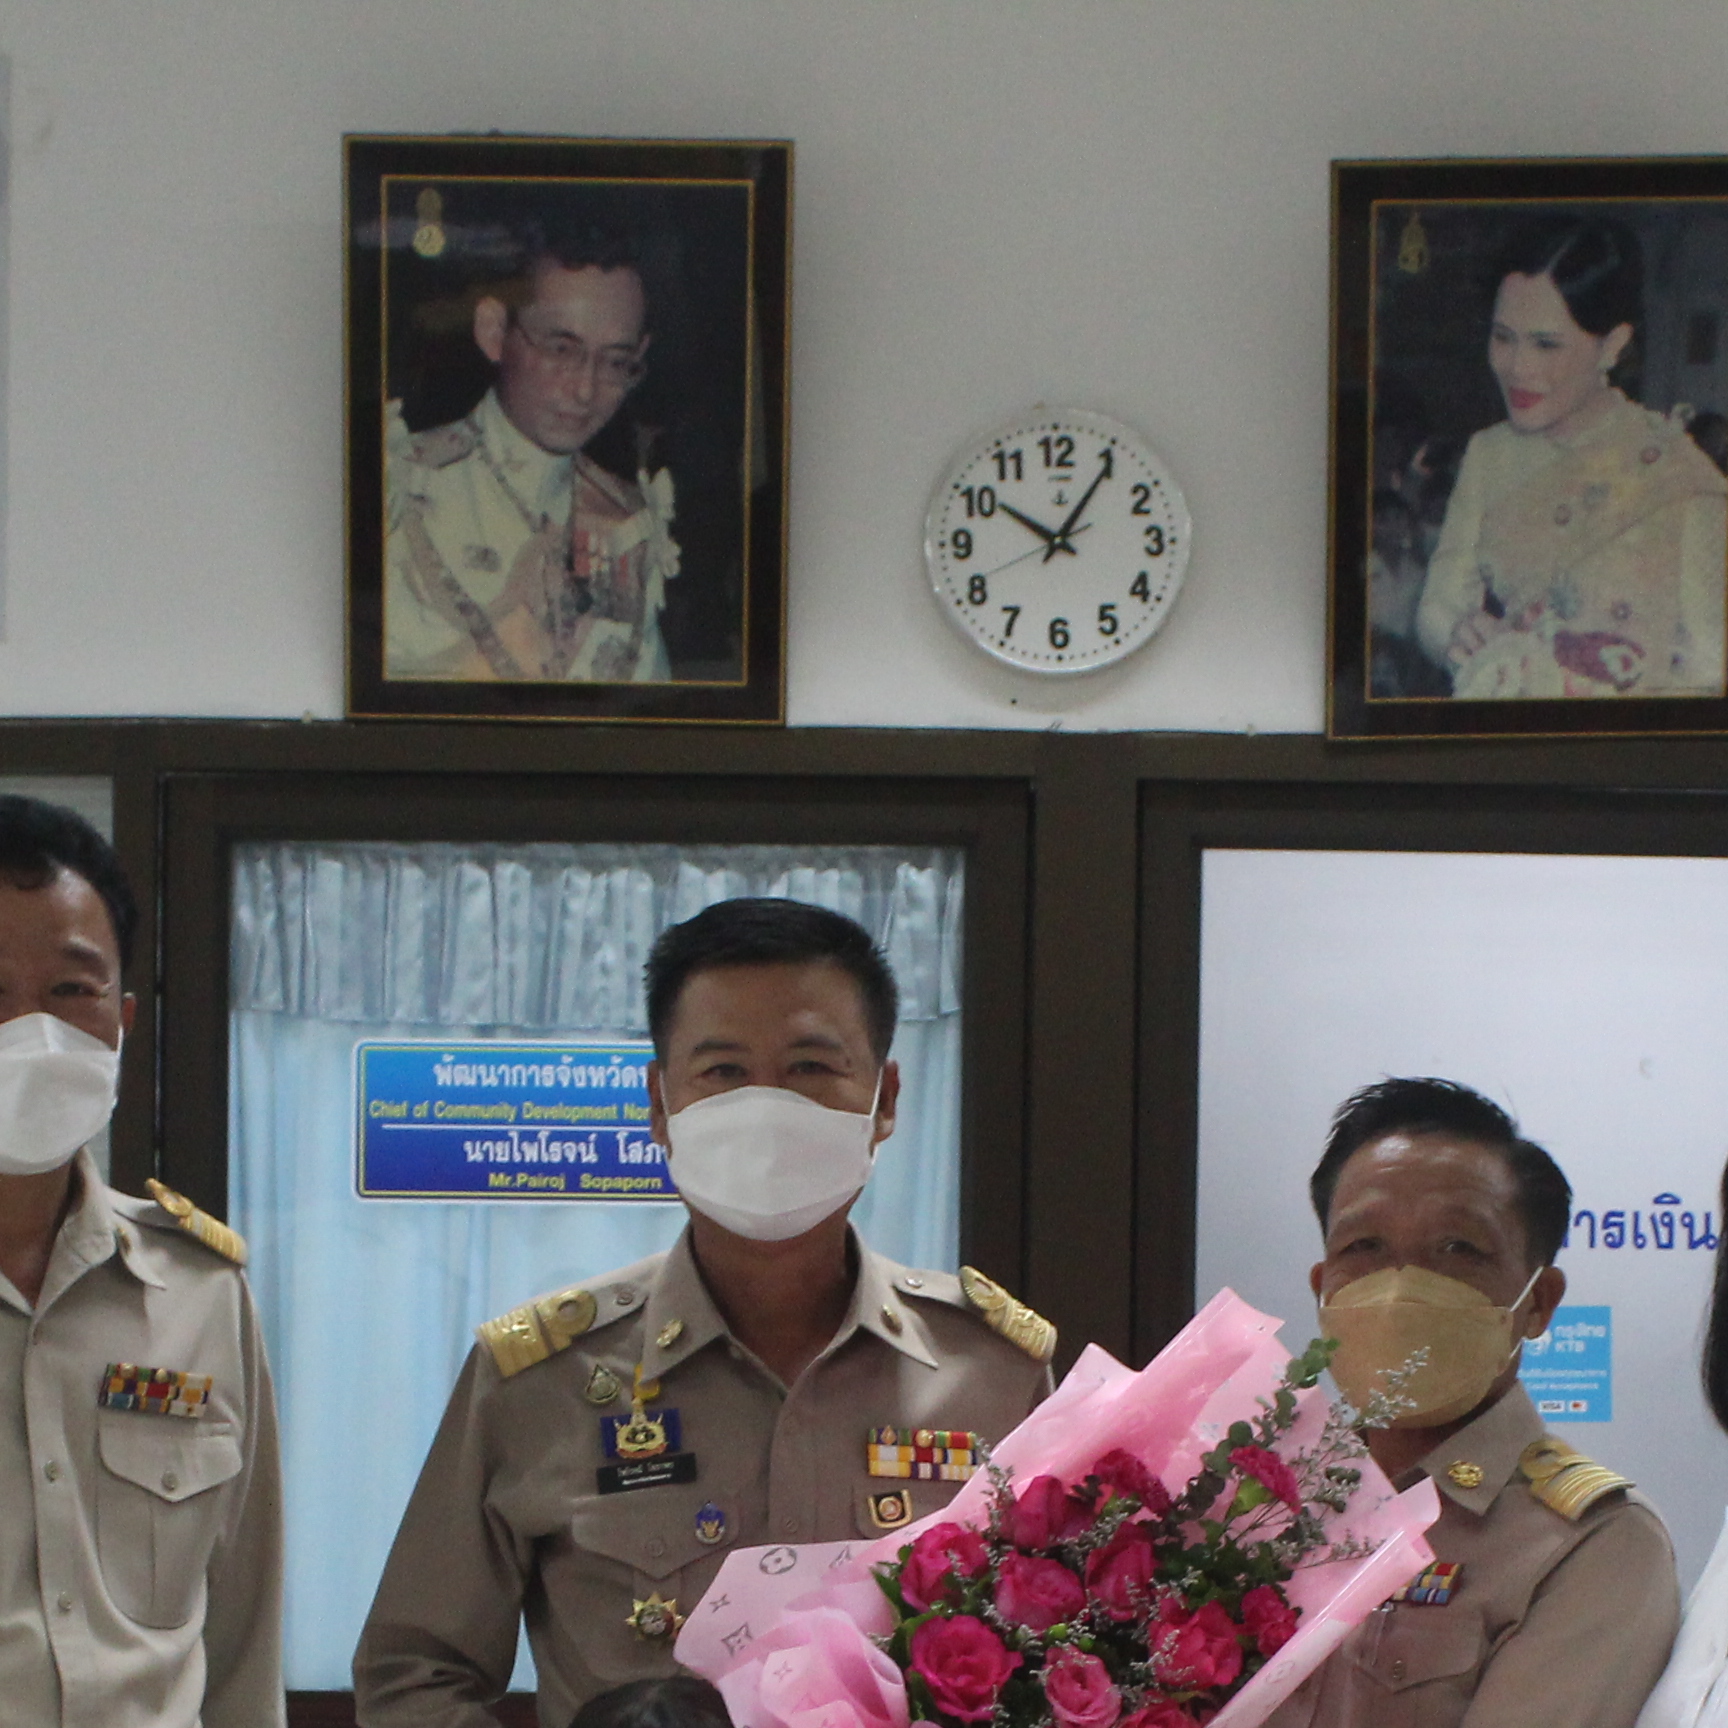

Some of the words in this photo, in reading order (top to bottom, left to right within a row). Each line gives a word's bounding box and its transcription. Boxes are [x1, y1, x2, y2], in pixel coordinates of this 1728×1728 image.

[991, 448, 1025, 482] 11
[1037, 434, 1076, 469] 12
[1098, 447, 1115, 480] 1
[959, 484, 997, 518] 10
[1130, 482, 1153, 516] 2
[951, 527, 974, 560] 9
[1143, 524, 1165, 557] 3
[967, 573, 989, 606] 8
[1129, 570, 1151, 603] 4
[1001, 605, 1022, 638] 7
[1048, 616, 1071, 650] 6
[1098, 602, 1120, 636] 5
[371, 1100, 409, 1119] Chief
[413, 1100, 430, 1118] of
[434, 1100, 518, 1123] Community
[522, 1101, 619, 1123] Development
[579, 1172, 663, 1191] Sopaporn
